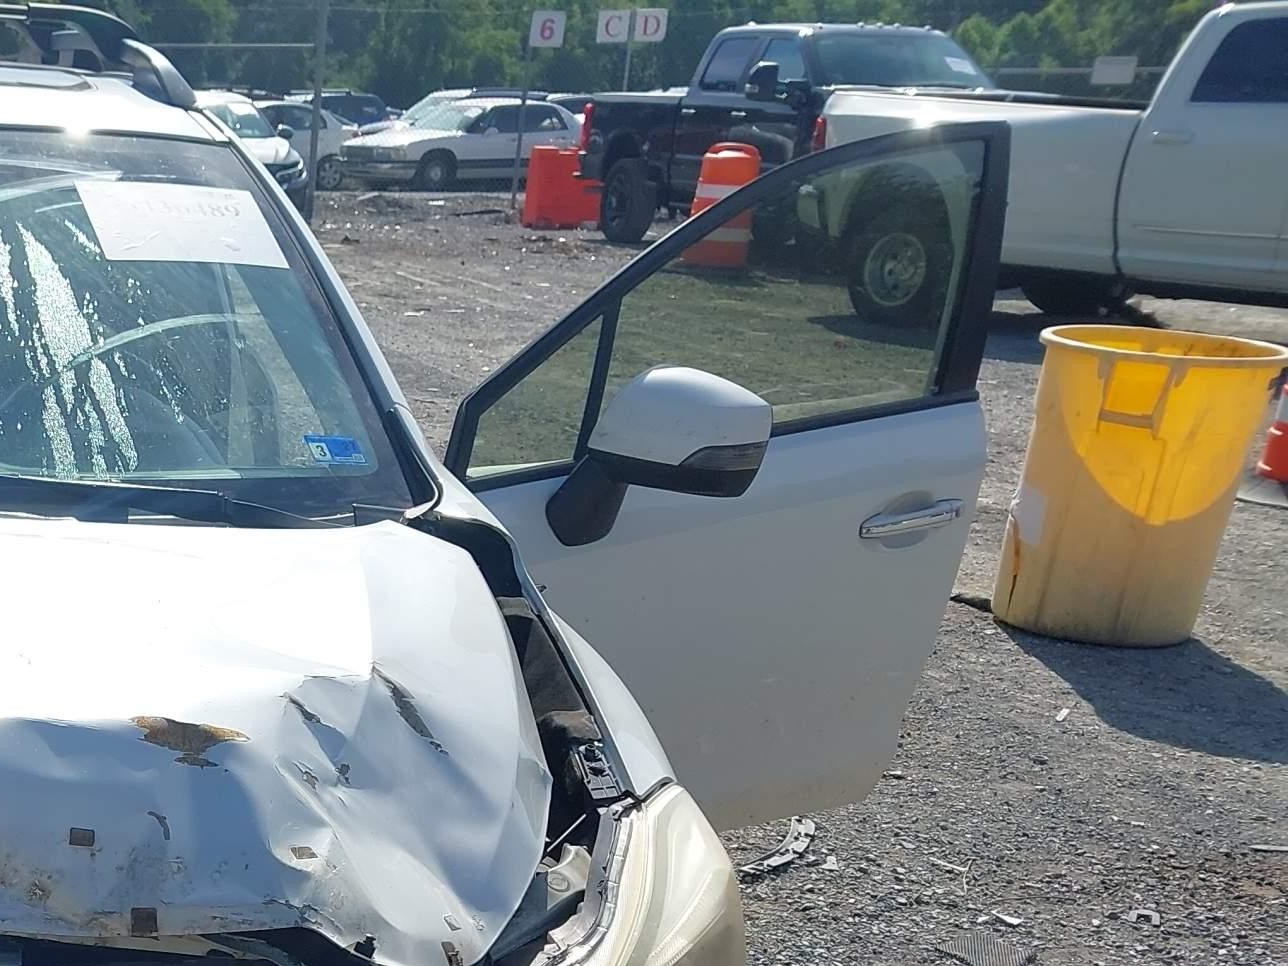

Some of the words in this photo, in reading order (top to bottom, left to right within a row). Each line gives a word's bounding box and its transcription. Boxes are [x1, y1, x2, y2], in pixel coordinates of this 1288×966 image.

[539, 17, 556, 41] 6
[604, 15, 623, 38] C
[641, 14, 661, 37] D
